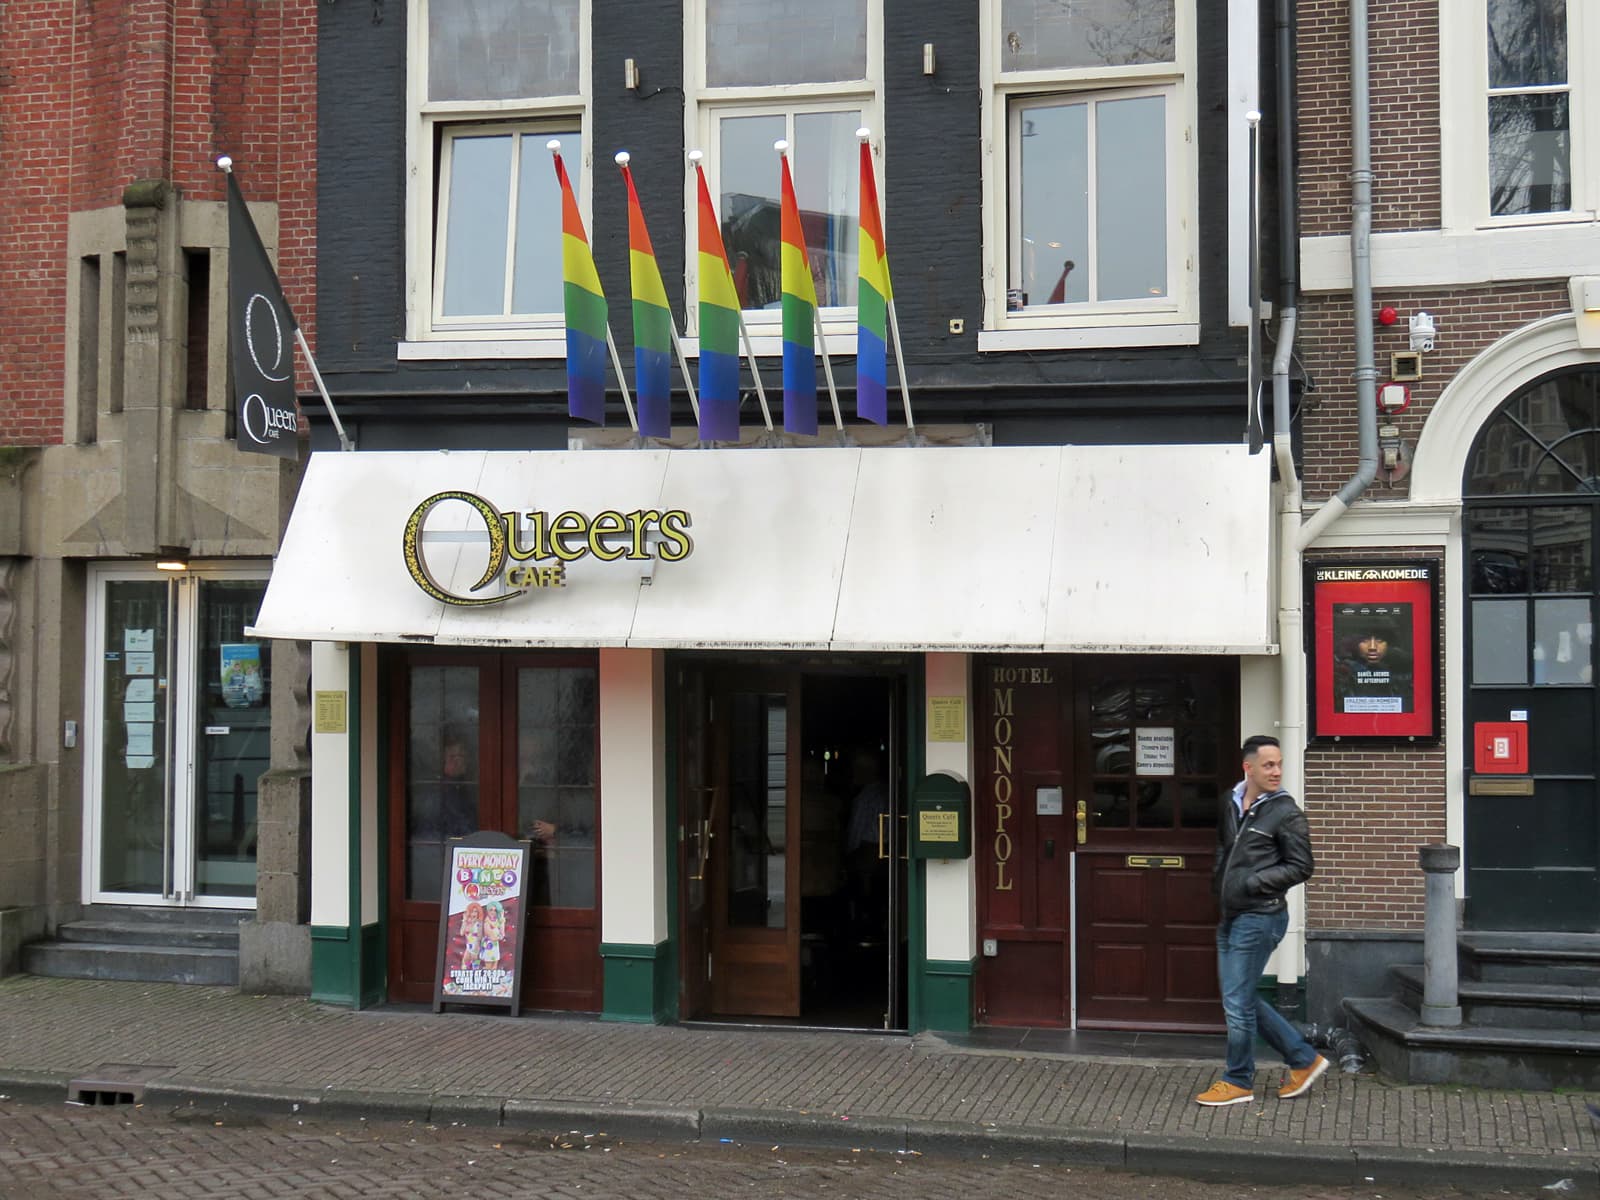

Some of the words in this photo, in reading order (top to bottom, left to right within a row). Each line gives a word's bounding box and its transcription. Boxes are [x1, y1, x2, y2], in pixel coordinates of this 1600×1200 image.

[242, 393, 297, 444] Queers
[403, 491, 692, 606] Queers
[1317, 571, 1324, 580] DE
[1325, 570, 1362, 580] KLEINE
[1381, 569, 1429, 579] KOMEDIE
[993, 667, 1054, 684] HOTEL
[993, 687, 1013, 890] MONOPOL
[457, 852, 482, 869] EVERY
[481, 853, 520, 870] MONDAY
[458, 868, 517, 886] BINGO
